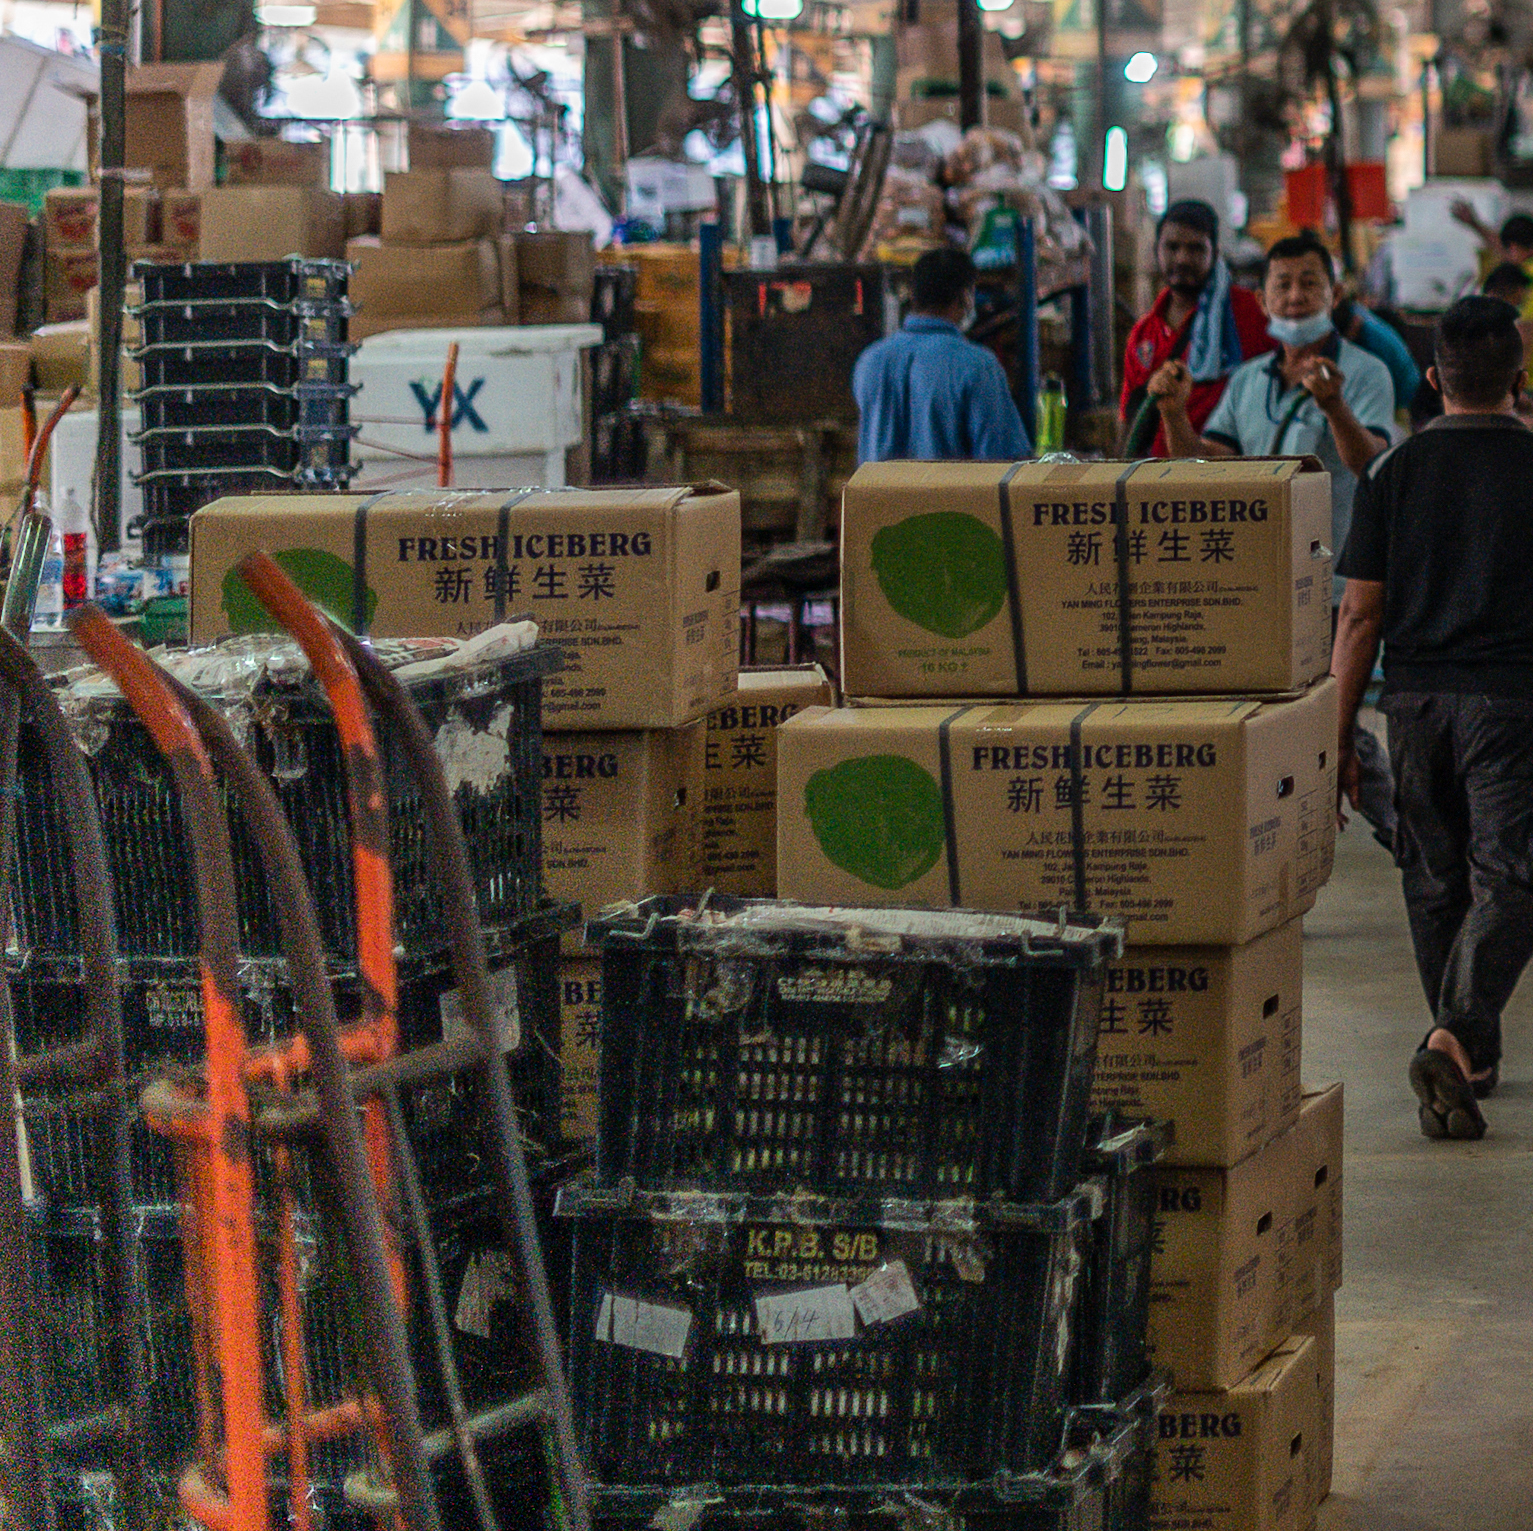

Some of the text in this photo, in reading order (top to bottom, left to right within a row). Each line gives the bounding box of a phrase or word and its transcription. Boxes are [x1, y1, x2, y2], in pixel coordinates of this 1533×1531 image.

[408, 377, 489, 434] YX
[1032, 499, 1269, 526] FRESH ICEBERG
[397, 532, 652, 562] FRESH ICEBERG
[1104, 598, 1147, 608] FLOERS
[707, 704, 799, 731] EBERG
[541, 753, 619, 779] BERG
[973, 742, 1218, 771] FRESH ICEBERG
[1107, 967, 1208, 993] EBERG
[1099, 998, 1174, 1037] 生菜
[746, 1229, 879, 1261] K.P.B. S/B
[1158, 1412, 1242, 1438] BERG
